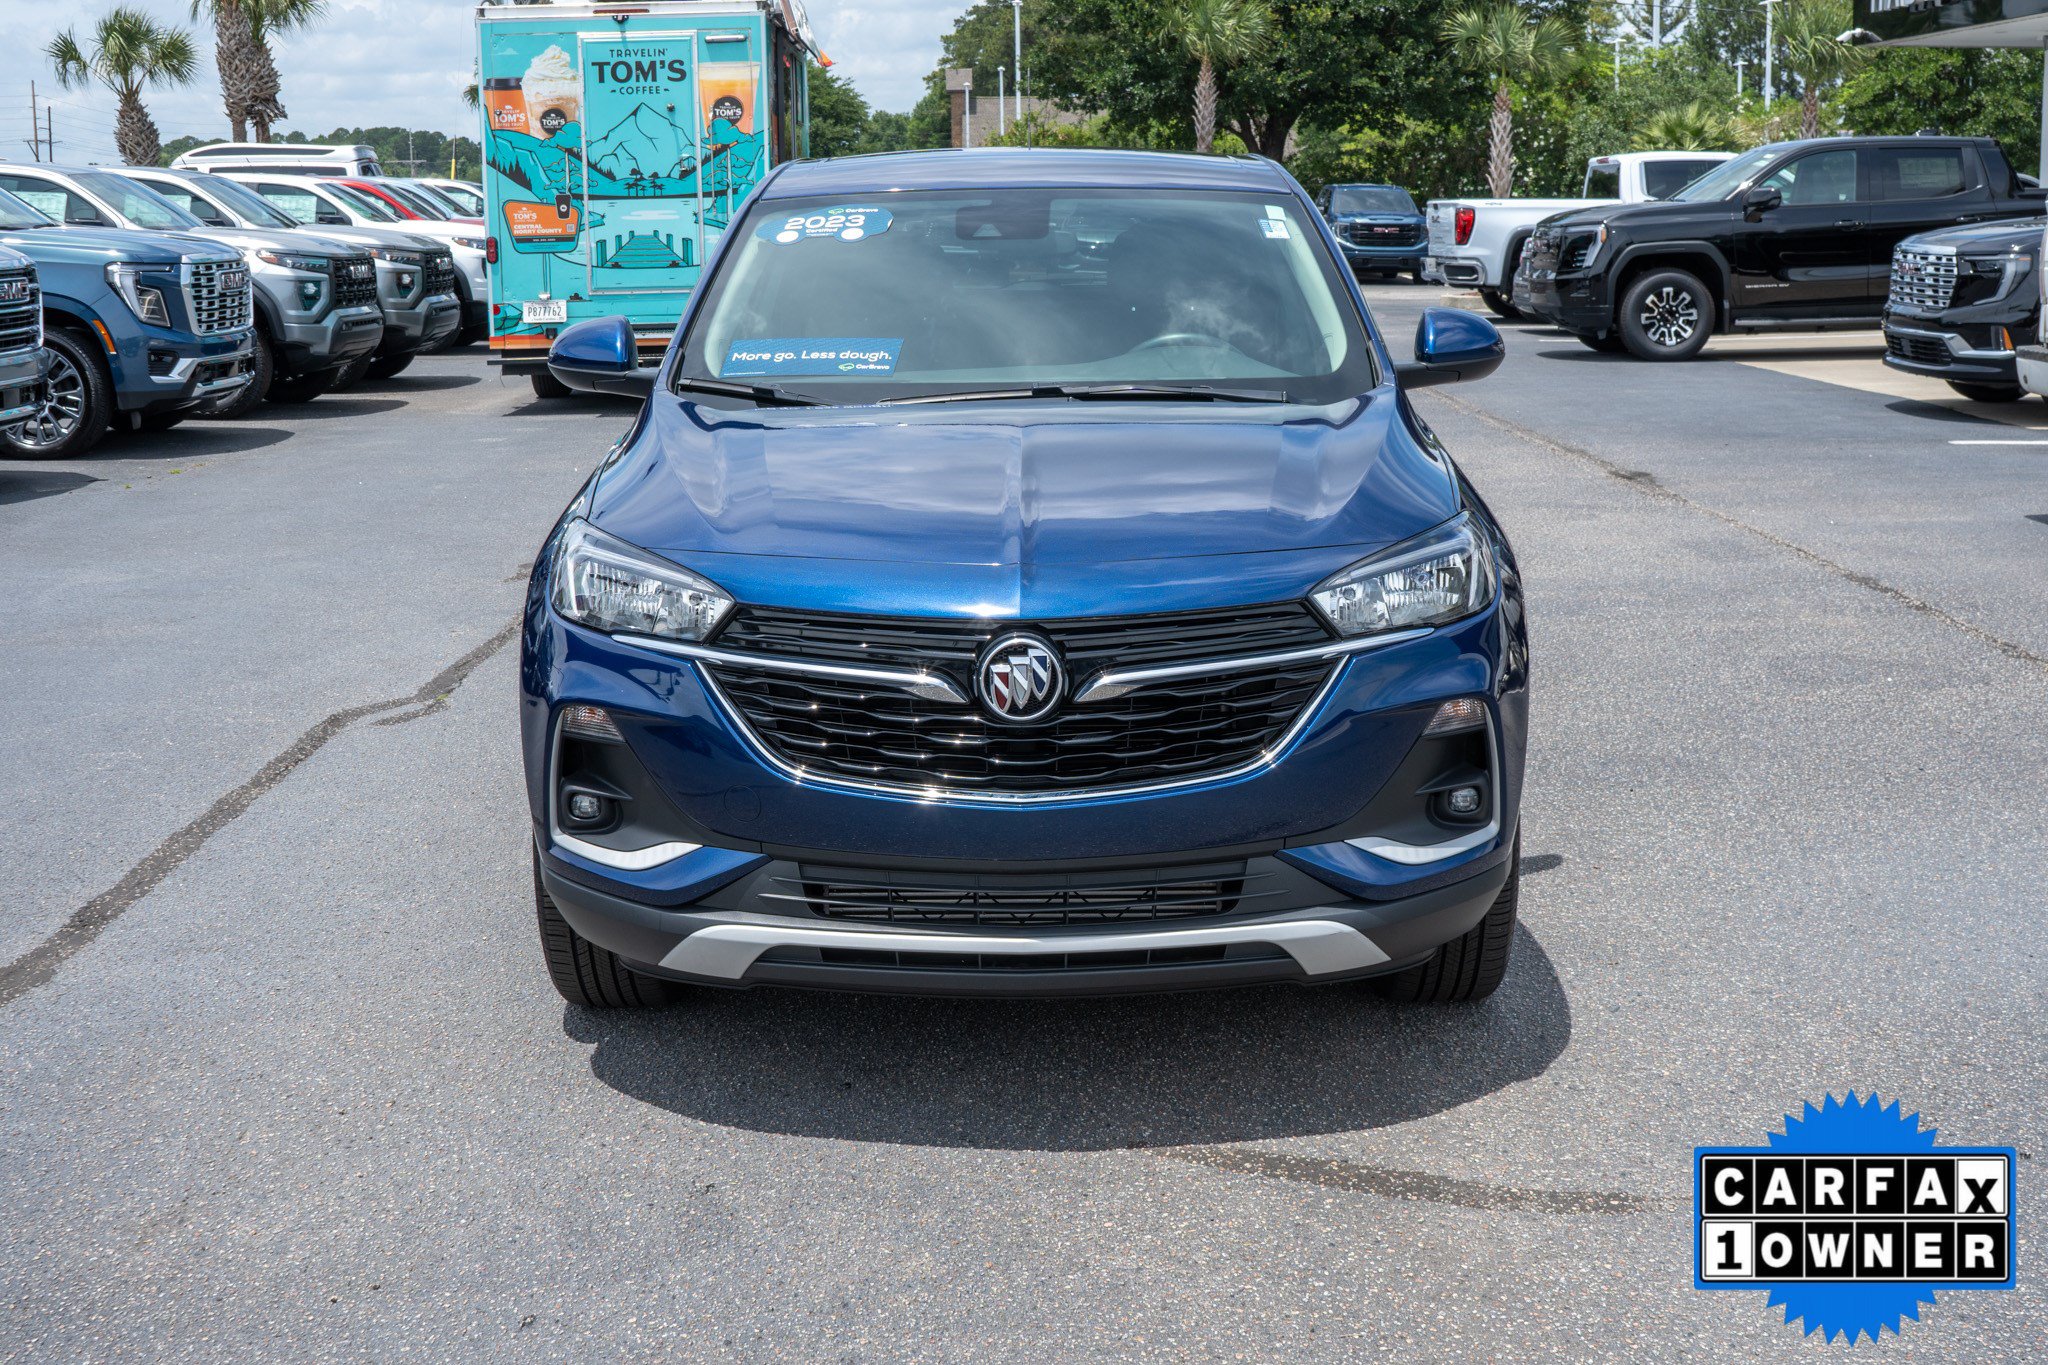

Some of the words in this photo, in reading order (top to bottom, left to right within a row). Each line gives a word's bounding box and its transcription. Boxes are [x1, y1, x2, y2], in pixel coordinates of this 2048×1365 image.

[609, 48, 668, 58] TRAVELIN'
[591, 59, 687, 83] TOM'S
[619, 86, 661, 95] COFFEE
[714, 108, 742, 116] TOM'S
[542, 118, 566, 126] TOM'S
[784, 214, 866, 230] 2023
[221, 272, 246, 289] GMC
[732, 352, 772, 361] More
[773, 352, 797, 362] go.
[801, 350, 836, 360] Less
[839, 350, 892, 362] dough.
